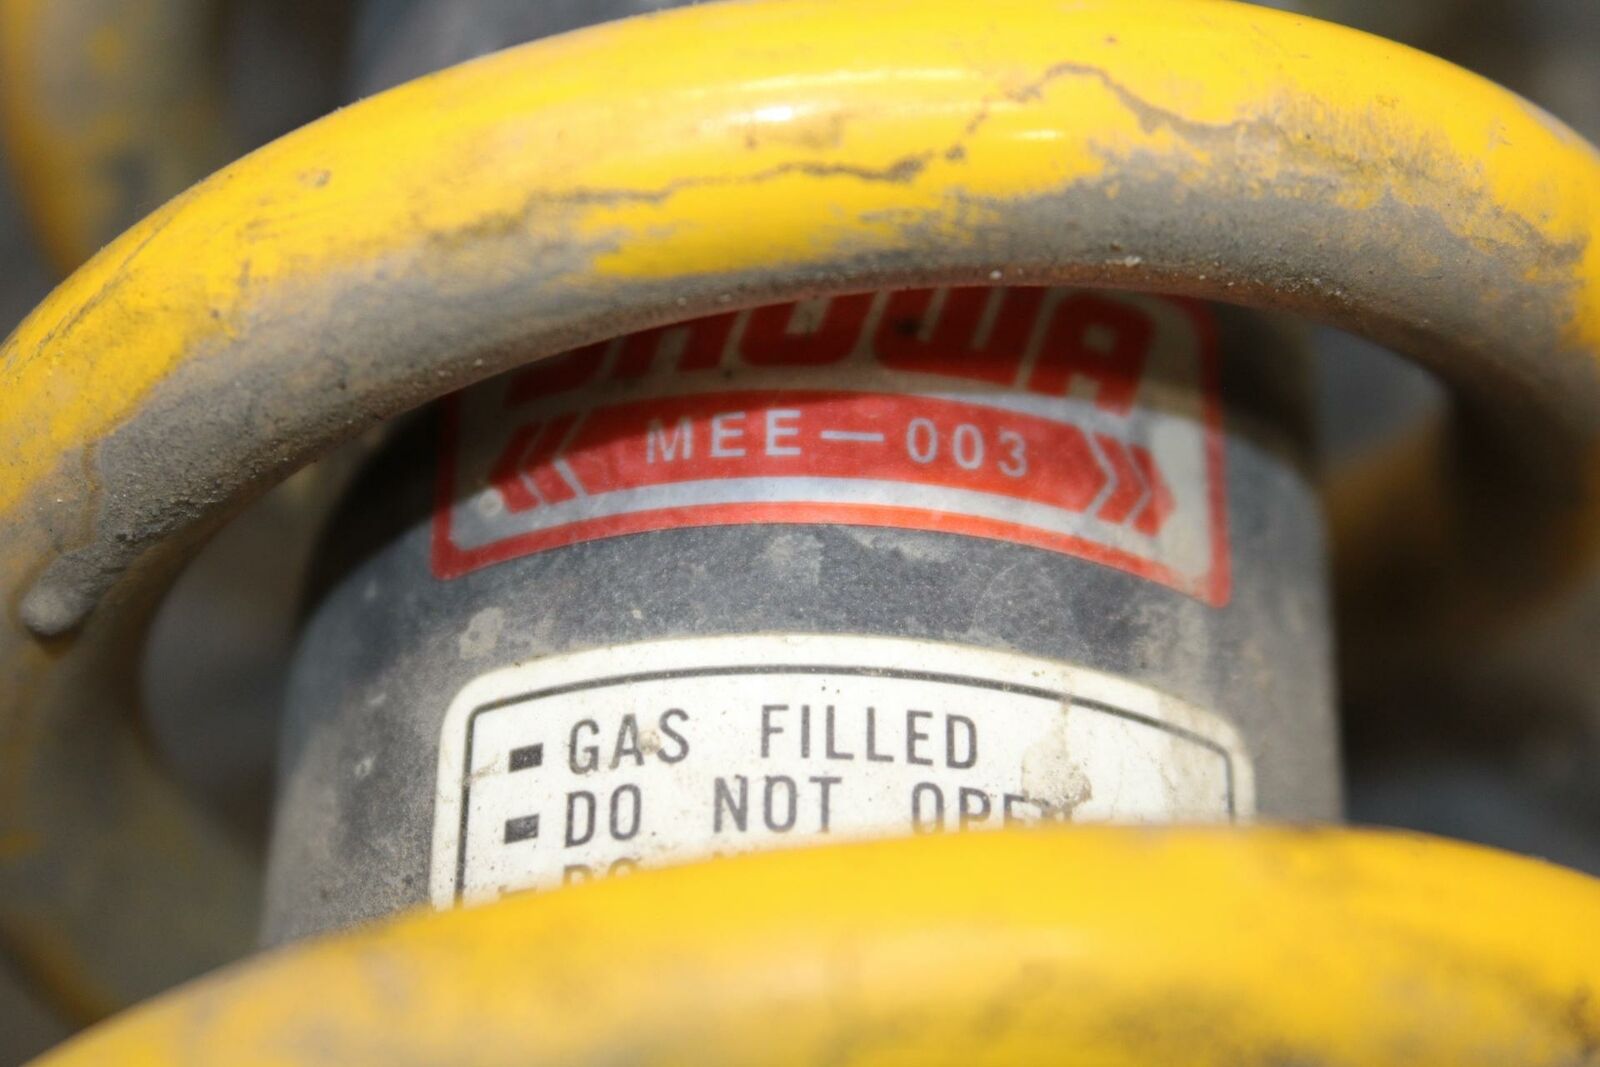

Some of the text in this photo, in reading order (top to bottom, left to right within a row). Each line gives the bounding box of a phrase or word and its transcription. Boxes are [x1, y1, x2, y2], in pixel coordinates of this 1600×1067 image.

[568, 703, 978, 775] GAS FILLED
[564, 783, 642, 849] DO
[713, 774, 843, 834] NOT
